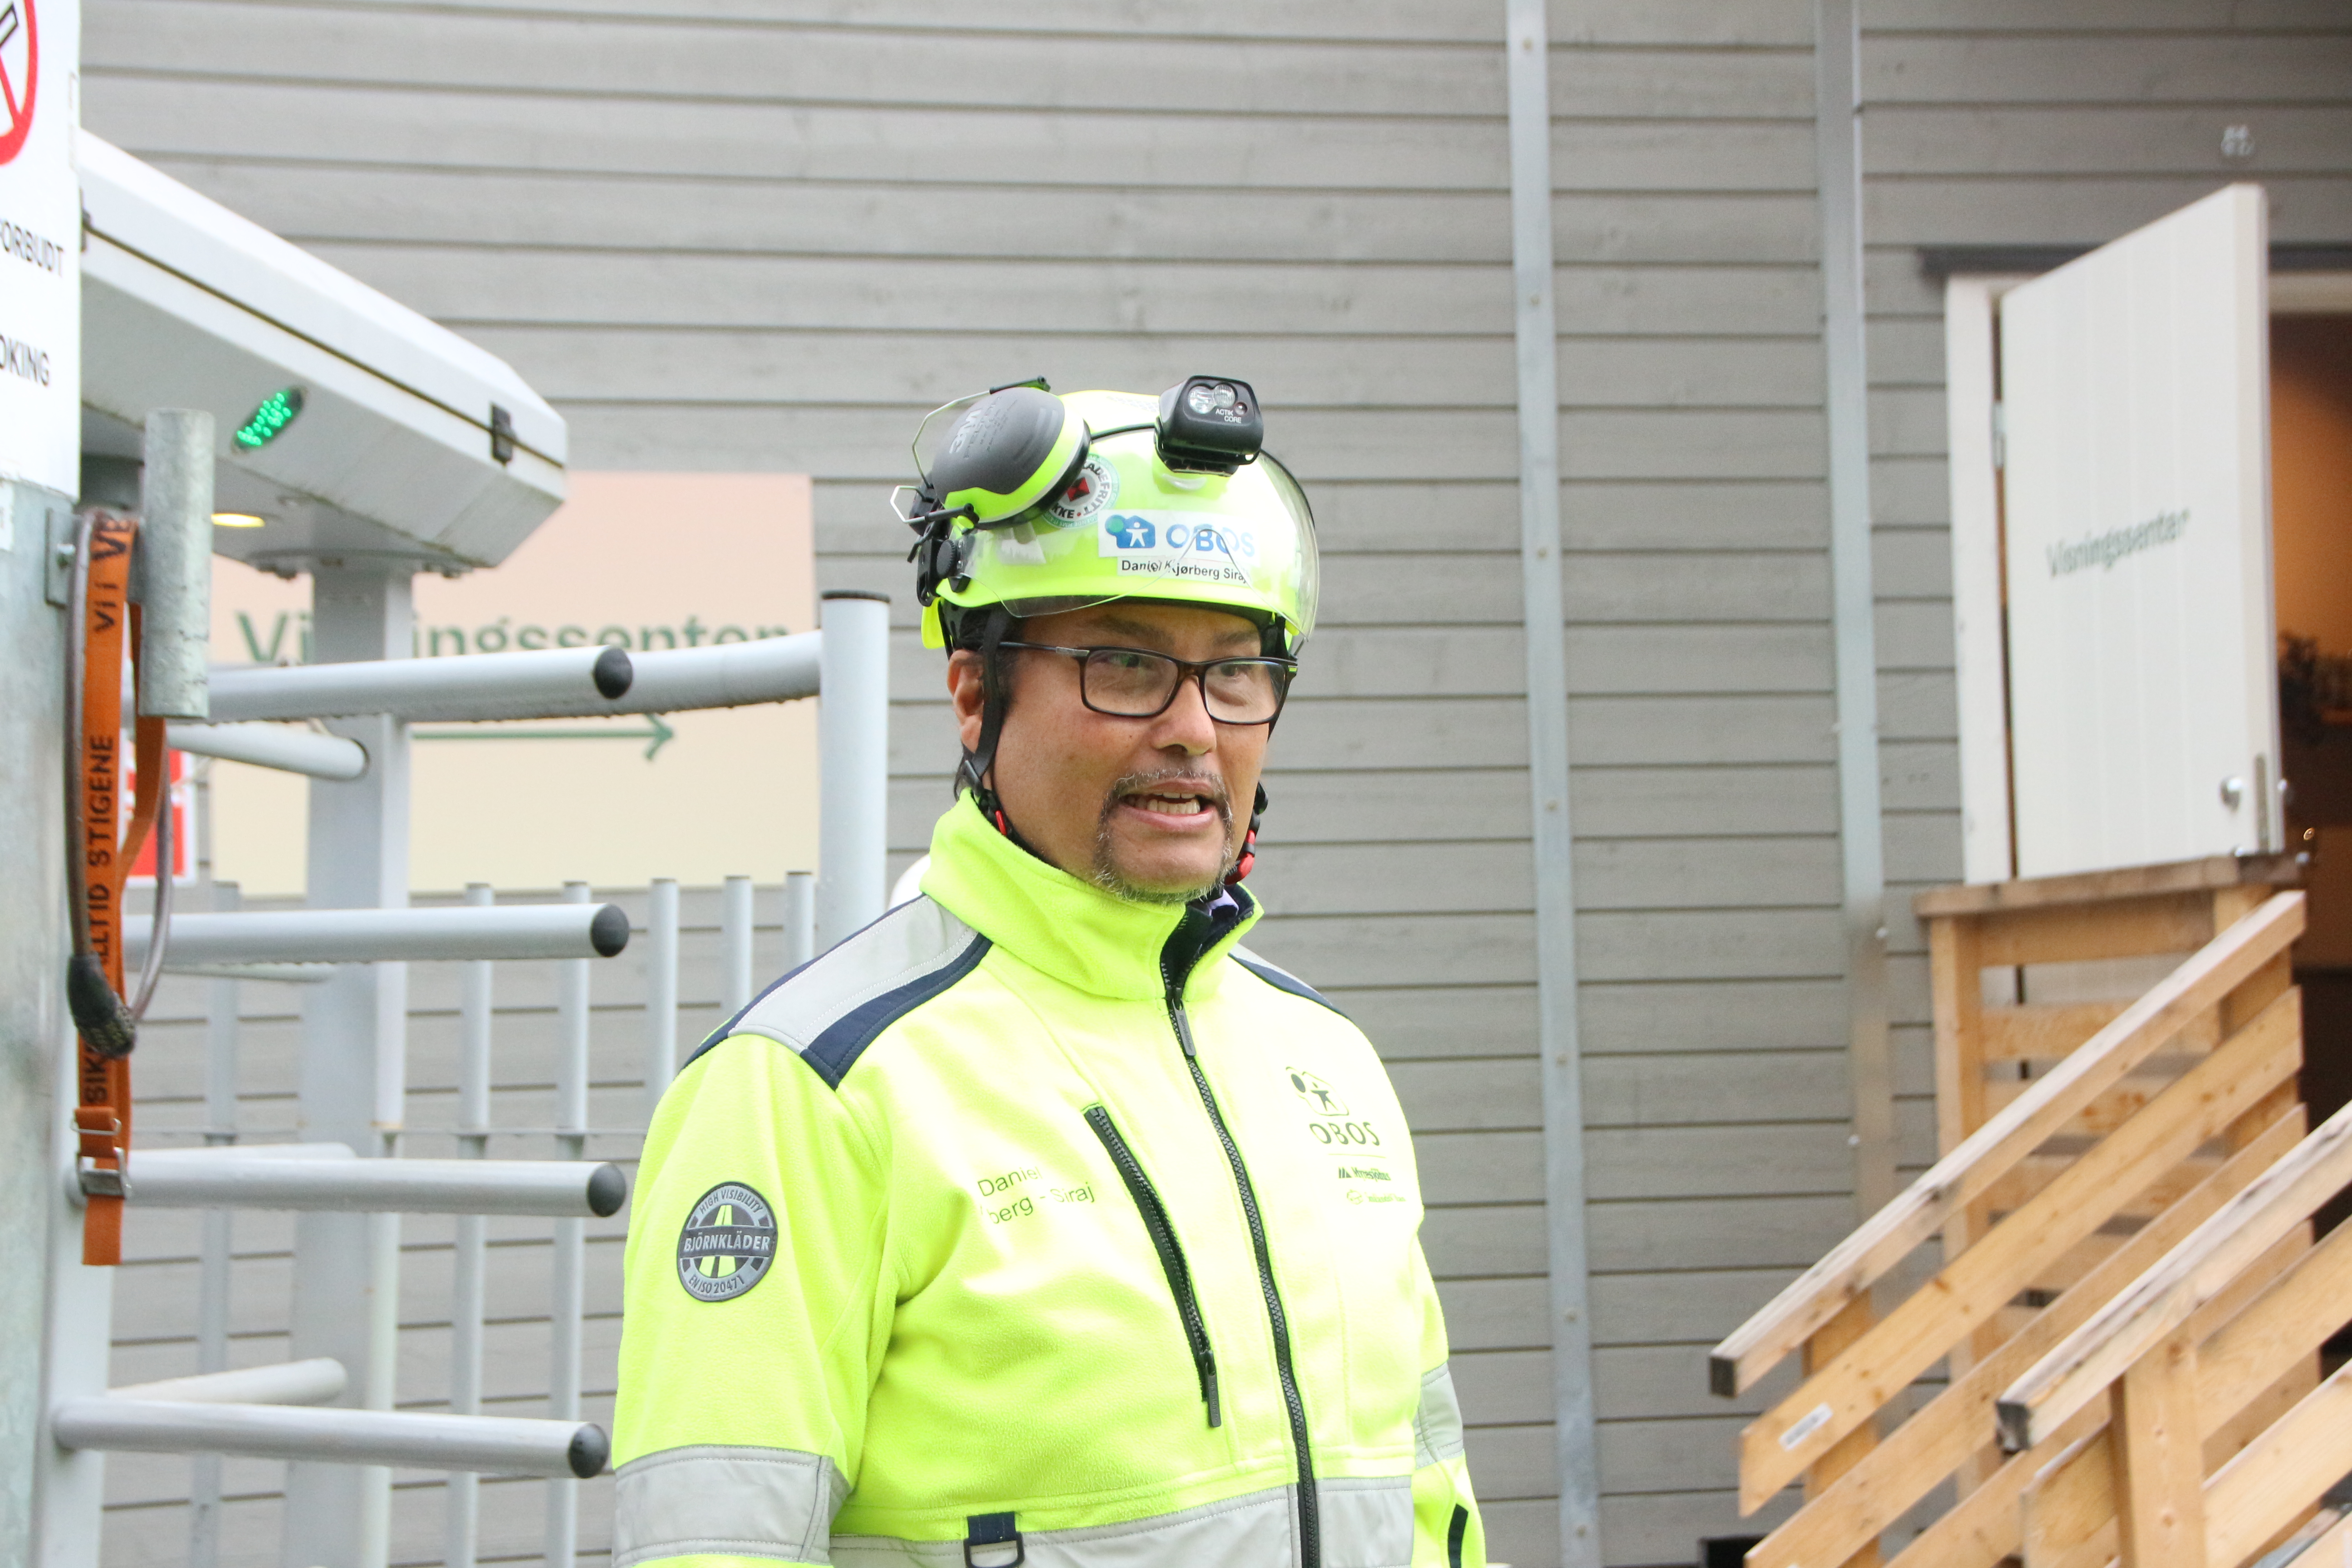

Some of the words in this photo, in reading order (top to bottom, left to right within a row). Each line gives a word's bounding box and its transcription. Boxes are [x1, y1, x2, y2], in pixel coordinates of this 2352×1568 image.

[0, 219, 64, 277] ORBUDT
[1166, 524, 1255, 558] OBOS
[1122, 559, 1162, 572] Daniel
[88, 735, 113, 867] STIGENE
[89, 884, 110, 965] LLTID
[1309, 1122, 1380, 1146] OBOS
[977, 1166, 1043, 1196] Daniel
[1050, 1181, 1095, 1203] Siraj
[699, 1191, 719, 1215] HIGH
[720, 1189, 763, 1213] VISIBILITY
[683, 1230, 771, 1252] BJÖRNKLÄDER
[689, 1275, 698, 1289] EN
[697, 1281, 712, 1294] ISO
[714, 1275, 745, 1294] 20471
